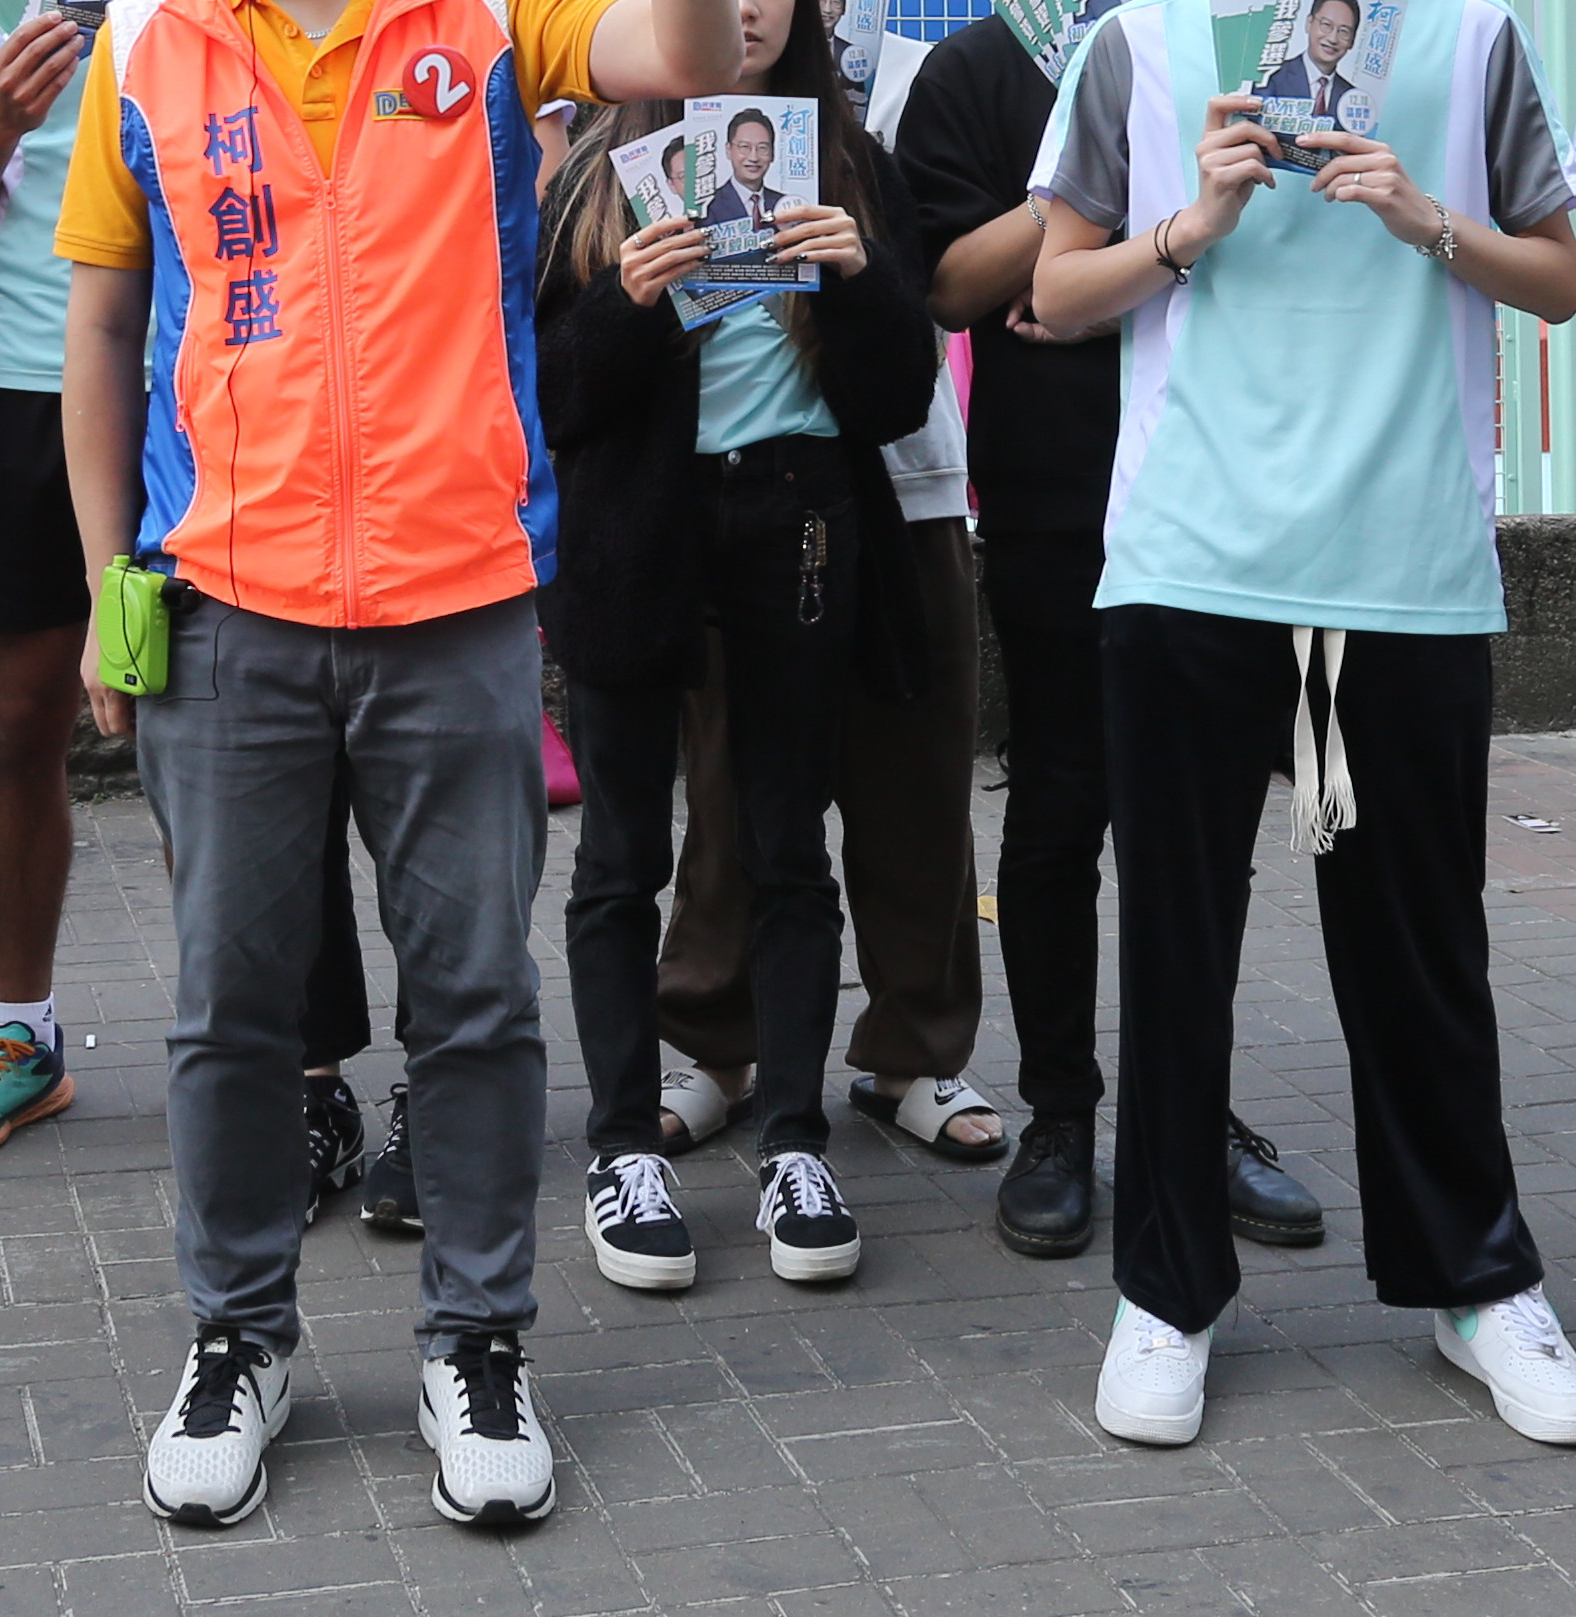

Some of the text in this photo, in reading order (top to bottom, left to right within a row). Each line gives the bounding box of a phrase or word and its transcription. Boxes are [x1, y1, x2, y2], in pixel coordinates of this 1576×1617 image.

[414, 53, 470, 113] 2
[780, 105, 812, 177] 柯創盛
[204, 105, 283, 346] 柯創盛
